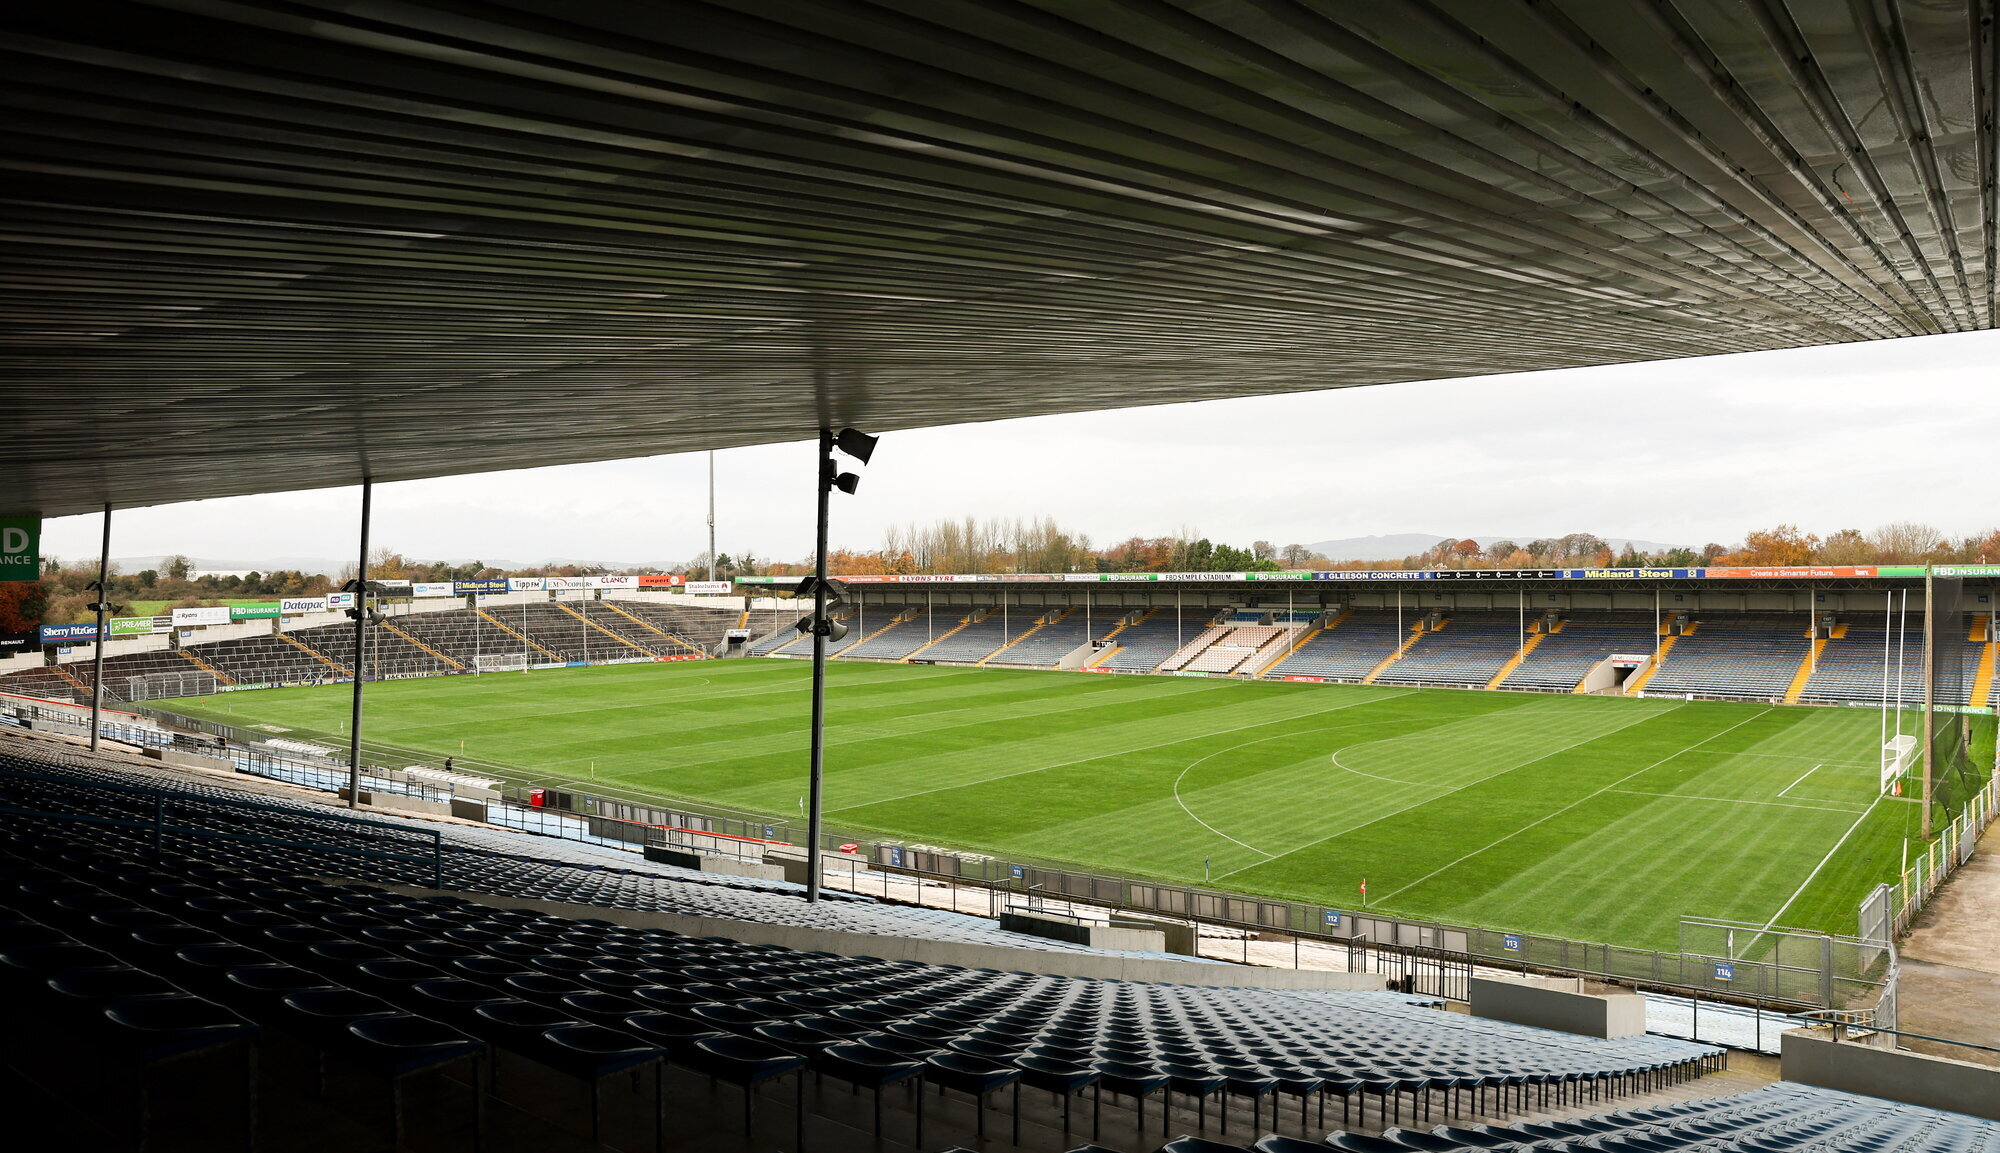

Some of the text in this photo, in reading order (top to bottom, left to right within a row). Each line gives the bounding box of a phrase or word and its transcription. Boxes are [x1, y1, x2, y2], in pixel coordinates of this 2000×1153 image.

[1584, 569, 1674, 578] Midland Steel
[1933, 568, 1956, 576] FBD
[514, 580, 531, 589] Tipp
[600, 576, 629, 584] CLANCY
[462, 581, 506, 589] Midland Steel
[283, 601, 325, 611] Datapac
[232, 607, 247, 615] FBD
[121, 620, 152, 629] PREMIER
[43, 627, 70, 637] Sherry
[1943, 706, 1987, 714] INSURANCE
[1505, 940, 1518, 949] 113
[1716, 968, 1732, 978] 114
